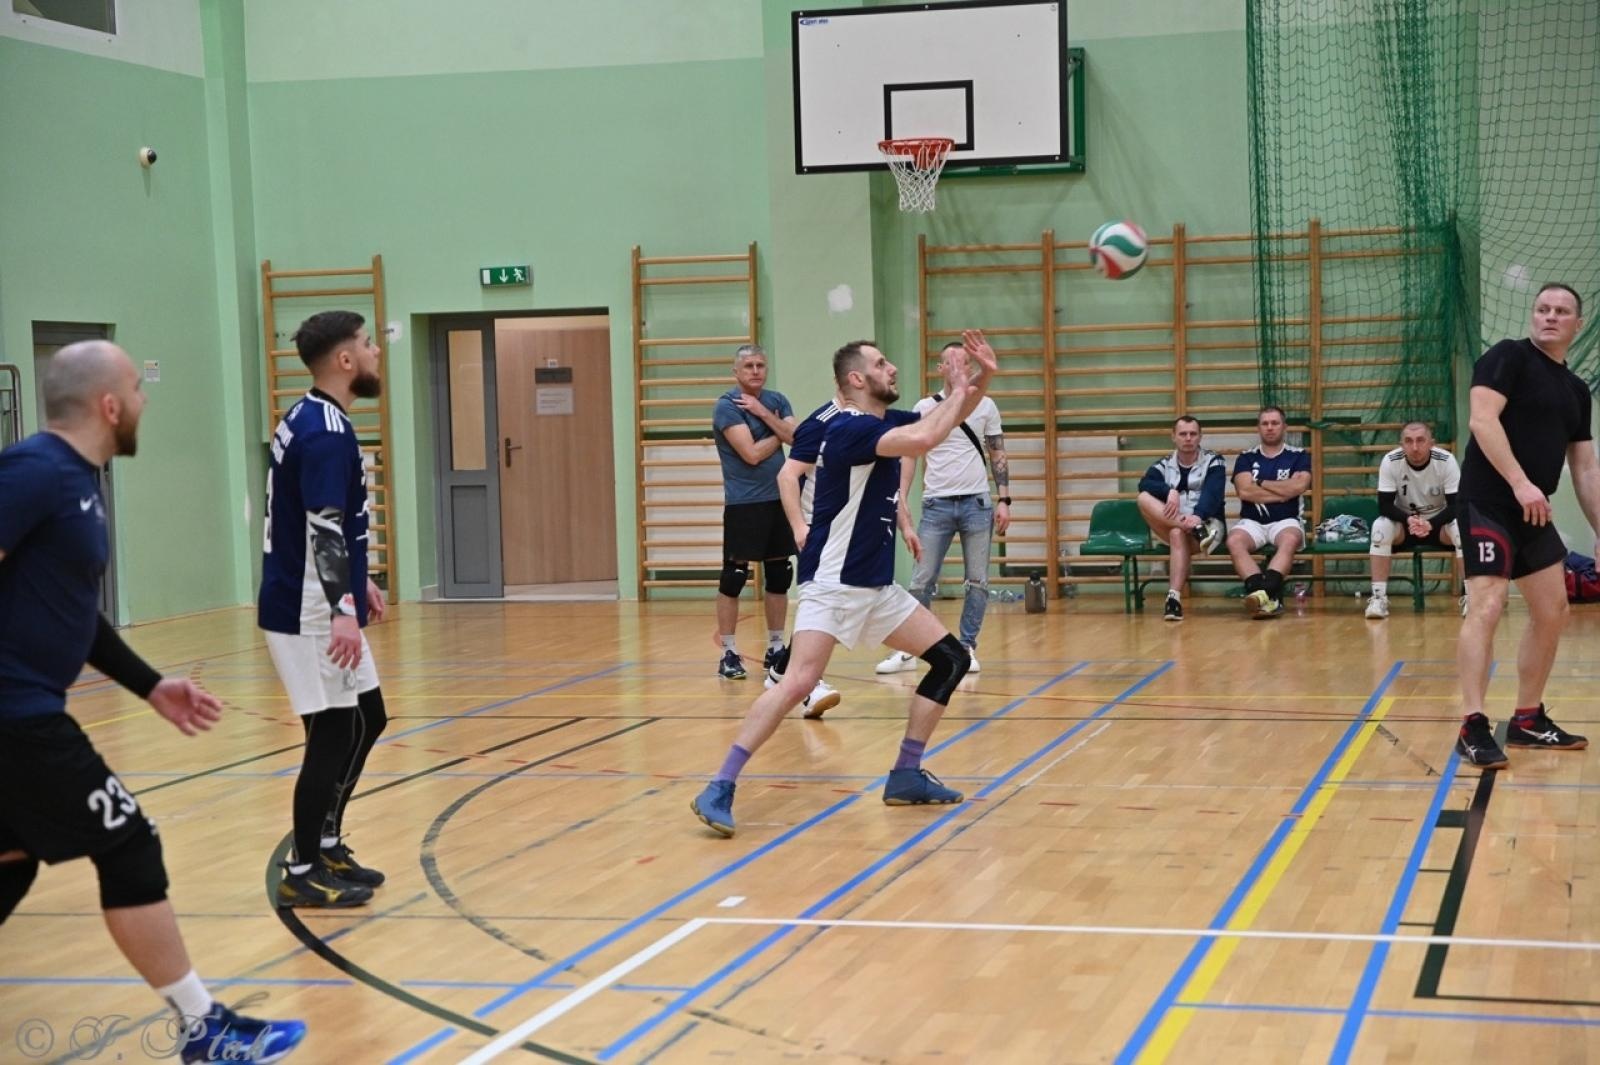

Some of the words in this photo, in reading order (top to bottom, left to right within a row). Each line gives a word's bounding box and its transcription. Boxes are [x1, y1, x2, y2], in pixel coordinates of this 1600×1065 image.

[1402, 484, 1407, 496] 1
[1478, 541, 1496, 563] 13
[87, 775, 137, 830] 23
